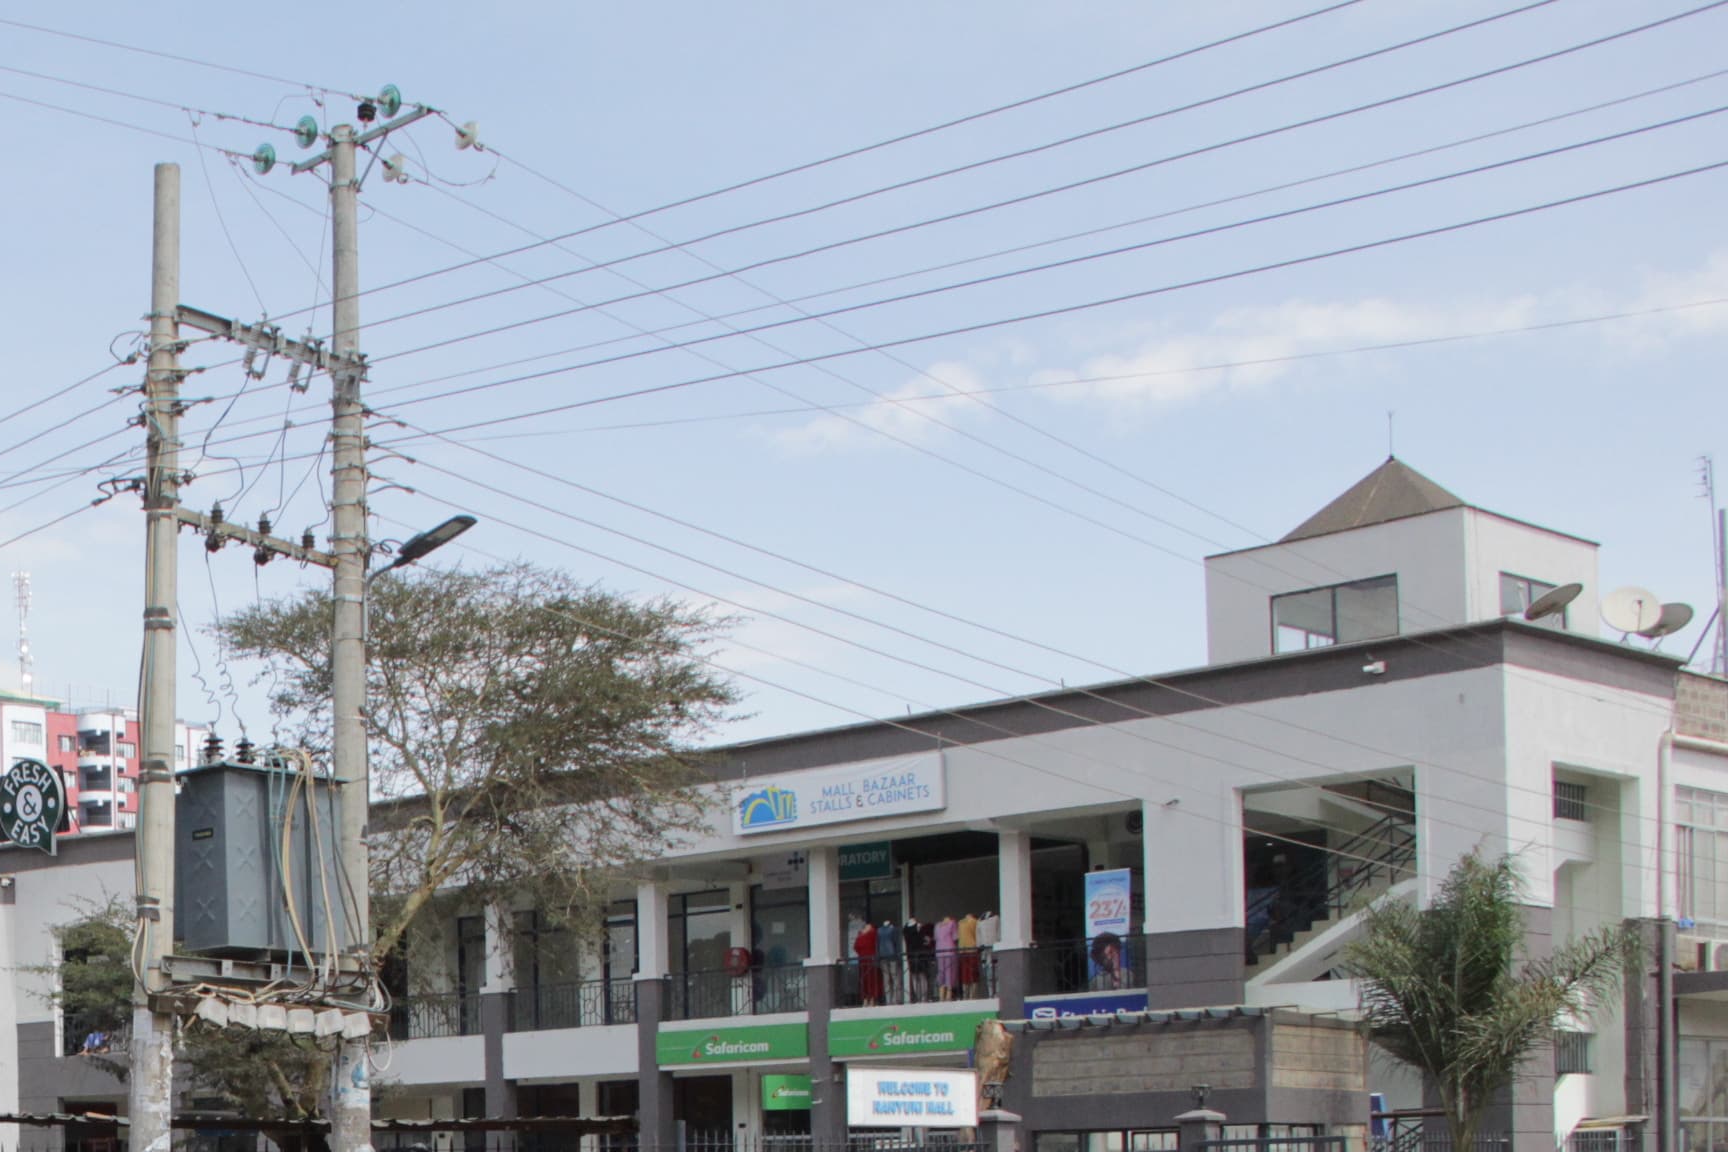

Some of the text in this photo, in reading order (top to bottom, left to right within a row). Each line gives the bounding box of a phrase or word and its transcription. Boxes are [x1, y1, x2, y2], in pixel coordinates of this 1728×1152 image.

[4, 761, 52, 796] FRESH
[822, 773, 915, 799] MALL BAZAAR
[23, 790, 38, 817] &
[810, 796, 852, 815] STALLS
[868, 784, 930, 807] CABINETS
[11, 816, 49, 846] EASY
[838, 850, 887, 867] RATORY
[706, 1039, 770, 1056] Safaricom
[883, 1030, 954, 1046] Safaricom
[876, 1081, 950, 1096] WELCOME TO
[925, 1100, 956, 1116] MALL
